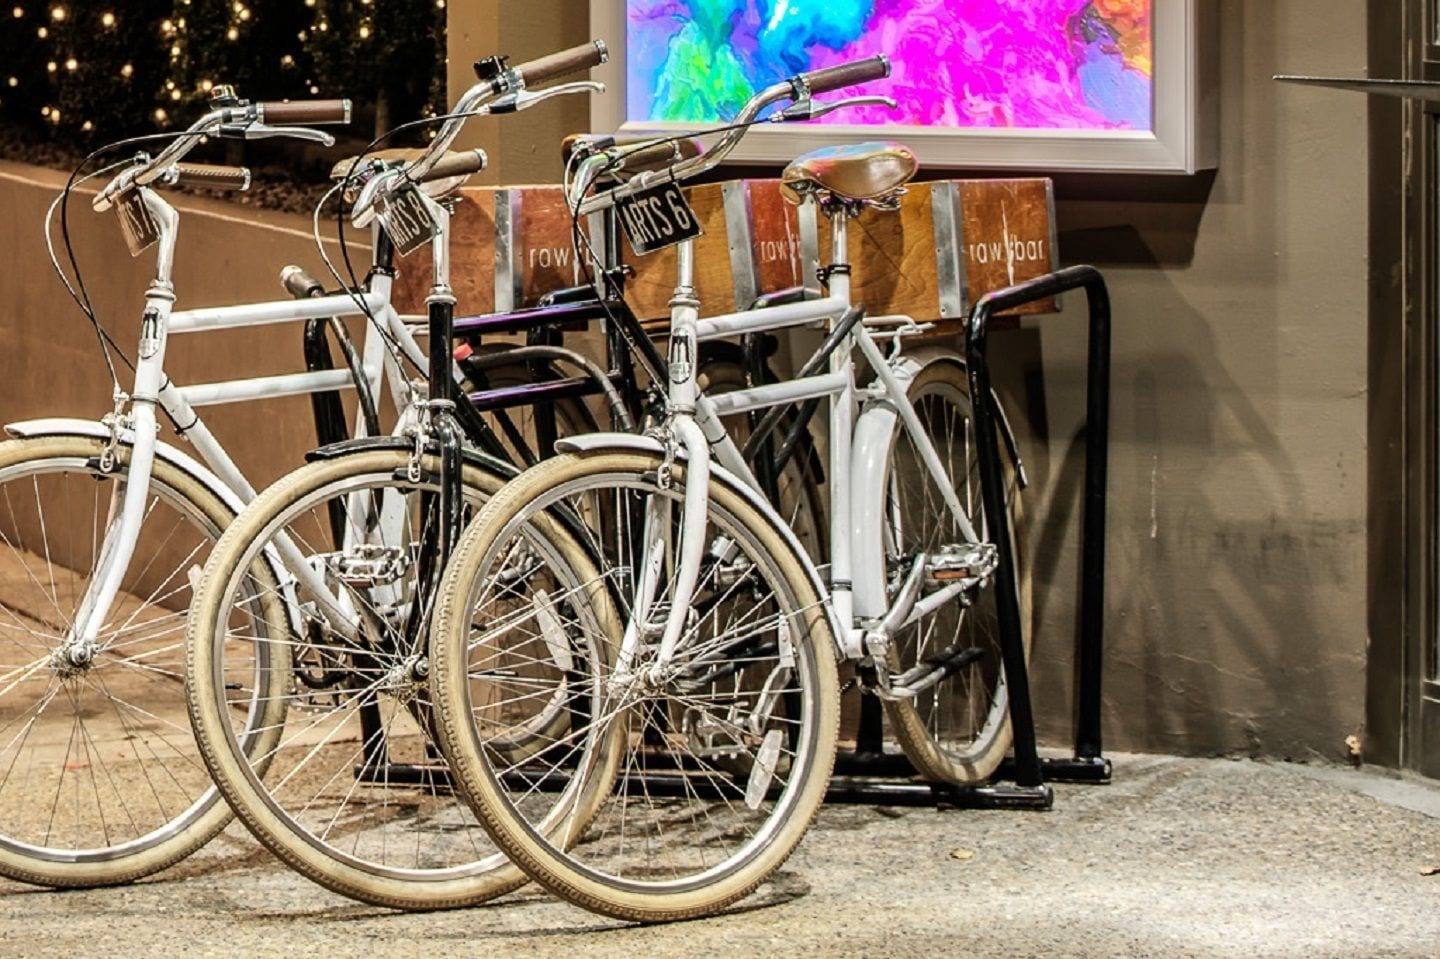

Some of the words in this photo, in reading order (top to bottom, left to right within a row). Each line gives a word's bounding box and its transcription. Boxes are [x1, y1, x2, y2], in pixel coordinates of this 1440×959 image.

[406, 190, 431, 229] 8
[622, 196, 674, 246] ARTS
[665, 190, 691, 230] 6
[529, 247, 570, 269] raw
[969, 242, 1001, 264] raw
[1013, 233, 1044, 261] bar
